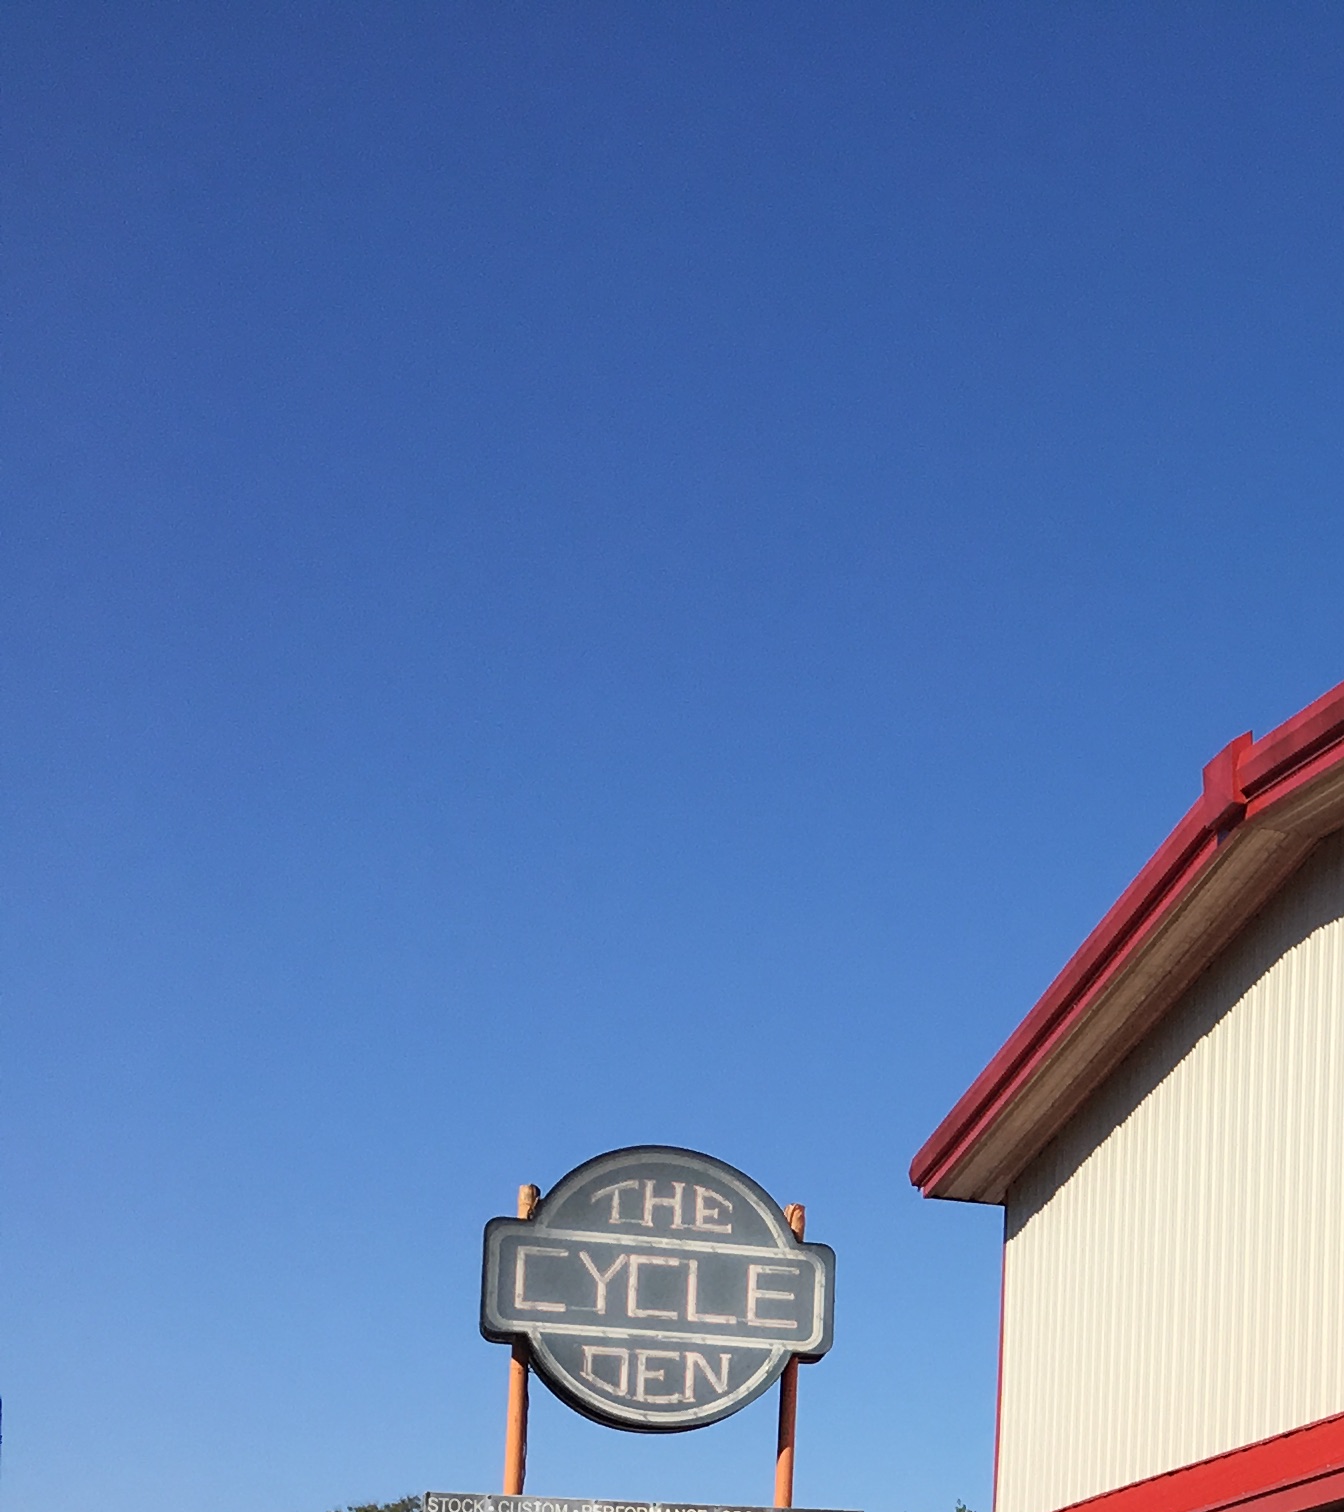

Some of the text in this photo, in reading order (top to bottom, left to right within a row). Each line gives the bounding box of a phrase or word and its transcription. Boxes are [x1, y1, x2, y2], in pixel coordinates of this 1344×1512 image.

[591, 1178, 734, 1235] THE
[513, 1244, 802, 1329] CYCLE
[579, 1344, 733, 1405] DEN
